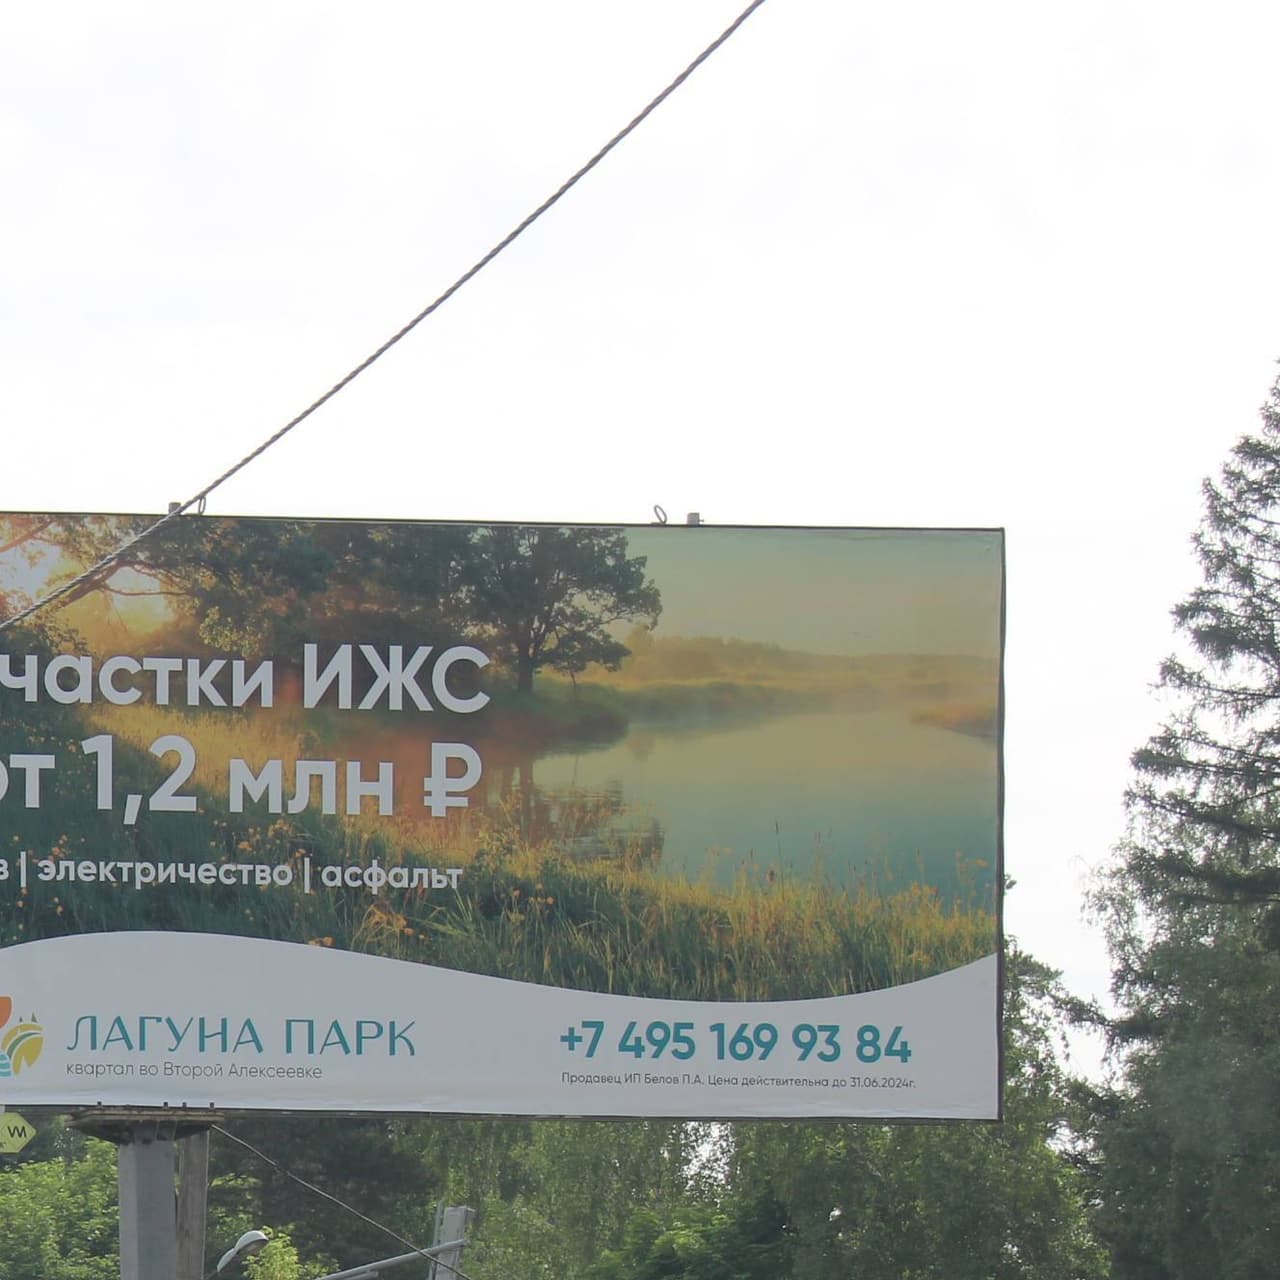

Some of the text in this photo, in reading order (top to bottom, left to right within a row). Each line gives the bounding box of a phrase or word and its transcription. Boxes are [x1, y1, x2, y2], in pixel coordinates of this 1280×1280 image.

[303, 643, 491, 713] ИЖС
[81, 734, 197, 825] 1,2
[229, 758, 393, 816] млн
[38, 857, 293, 890] электричество
[321, 859, 463, 895] асфальт
[67, 1016, 416, 1056] ЛАГУНА ПАРК
[560, 1021, 912, 1063] +7 495 169 93 84
[66, 1062, 322, 1079] квартал во Второй Алексеевке
[562, 1072, 621, 1084] Продавец
[625, 1073, 640, 1083] ИП
[644, 1074, 679, 1084] Белов
[682, 1074, 704, 1085] П.А.
[708, 1075, 738, 1087] Цена
[742, 1075, 829, 1087] действительна
[832, 1078, 847, 1089] до
